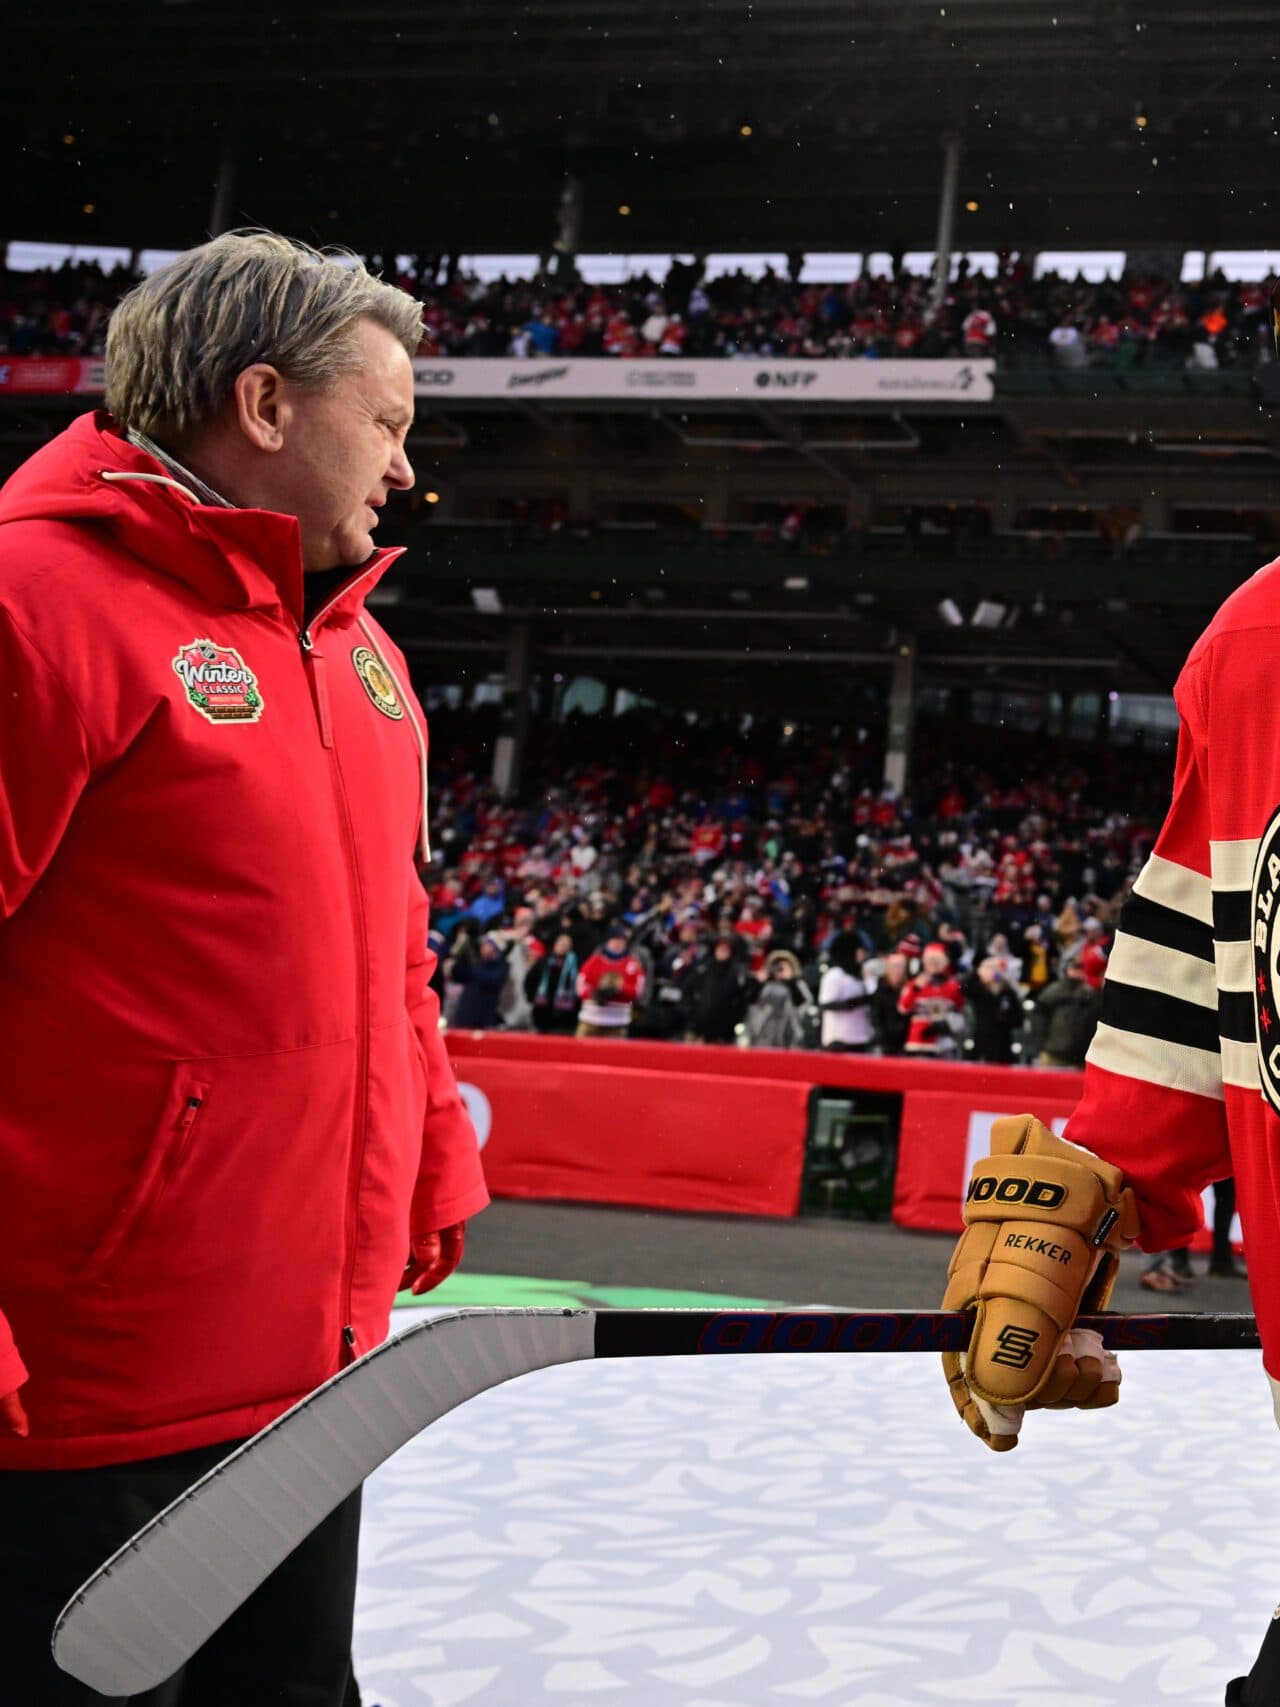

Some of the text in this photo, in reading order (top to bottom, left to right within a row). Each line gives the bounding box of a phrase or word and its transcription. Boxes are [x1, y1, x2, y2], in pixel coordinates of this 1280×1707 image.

[175, 659, 253, 689] Winter
[202, 684, 244, 694] CLASSIC
[1004, 1233, 1073, 1265] REKKER
